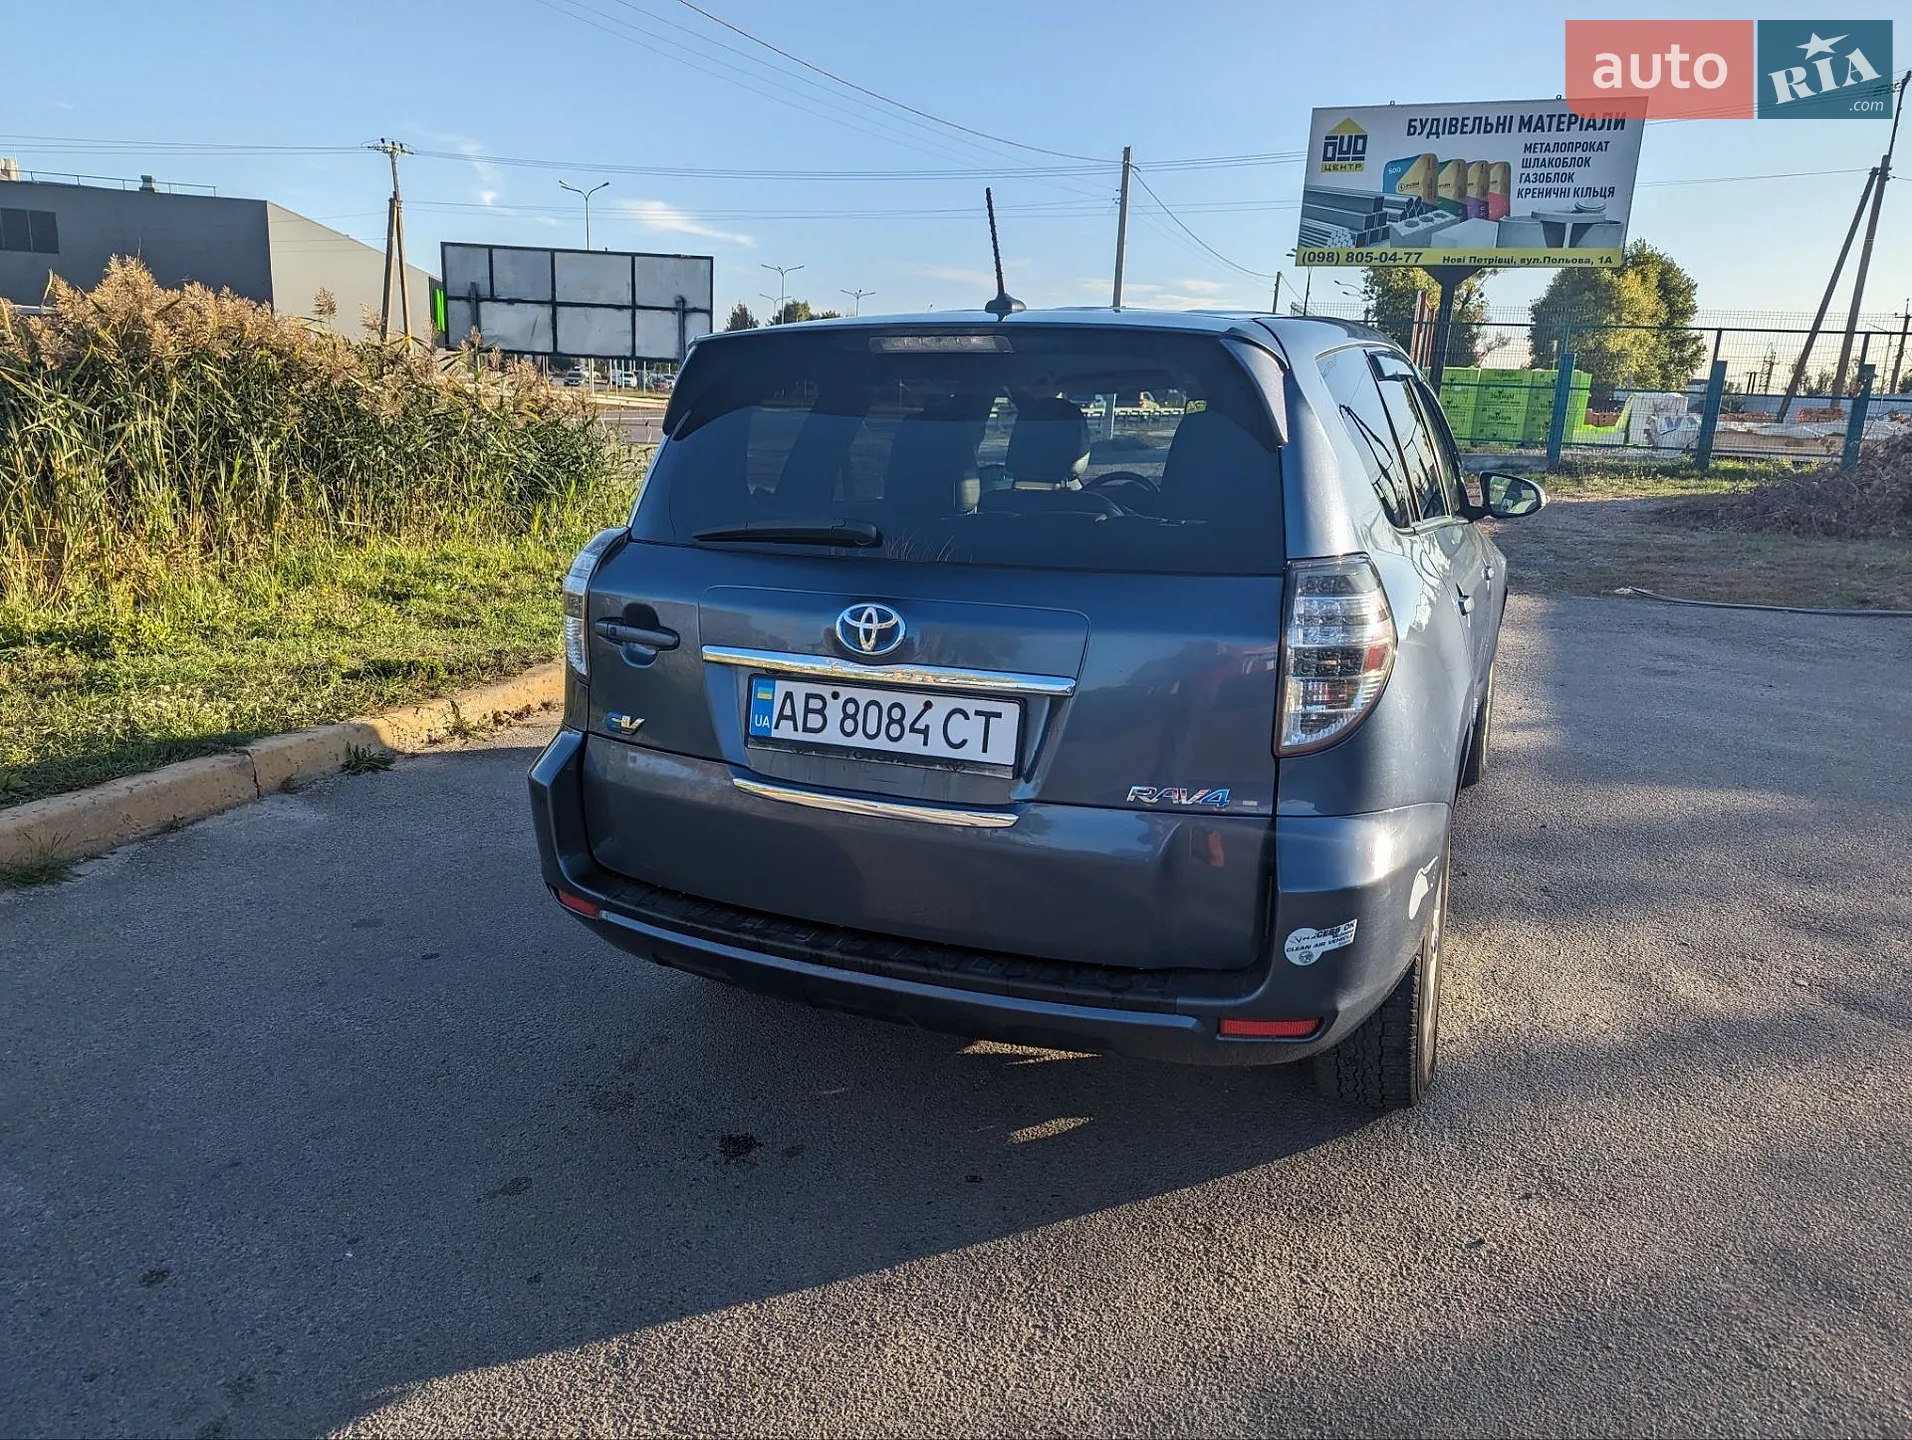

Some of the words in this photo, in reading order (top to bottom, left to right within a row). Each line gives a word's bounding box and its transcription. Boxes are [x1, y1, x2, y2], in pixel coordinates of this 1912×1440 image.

[1406, 115, 1514, 139] БУДІВЕЛЬНІ
[1517, 112, 1627, 134] МАТЕРІАЛИ
[1523, 141, 1610, 154] МЕТАЛОПРОКАТ
[1323, 163, 1363, 172] ЦЕНТР
[1521, 156, 1592, 169] ШЛАКОБЛОК
[1519, 171, 1575, 184] ГАЗОБЛОК
[1517, 186, 1571, 200] КРЕНИЧНІ
[1573, 186, 1616, 199] КІЛЬЦЯ
[1302, 251, 1340, 265] (098)
[1345, 251, 1423, 264] 805-04-77
[1442, 256, 1466, 264] Нові
[1468, 256, 1517, 266] Петрівці,
[754, 714, 771, 728] UA
[773, 691, 829, 735] AB
[839, 696, 931, 747] 8084
[942, 707, 1003, 754] CT
[1126, 786, 1231, 808] RAV4
